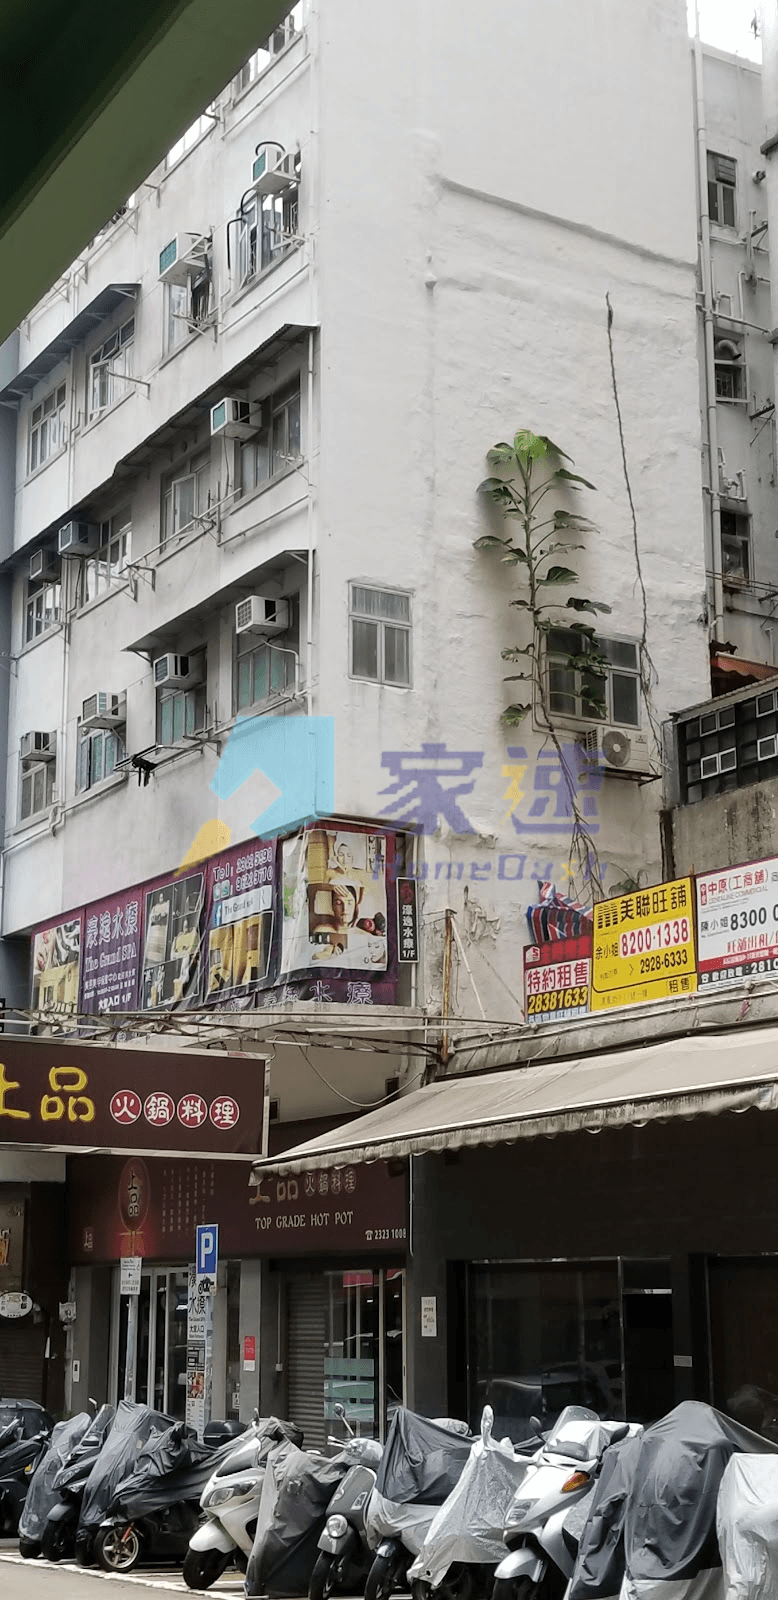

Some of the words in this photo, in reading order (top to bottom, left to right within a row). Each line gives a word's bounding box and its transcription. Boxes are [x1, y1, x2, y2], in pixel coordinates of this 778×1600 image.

[731, 907, 767, 931] 8300
[402, 949, 416, 959] 1/F
[527, 961, 589, 993] 特約租售
[527, 986, 589, 1014] 28381633
[112, 1092, 239, 1127] 火鍋料理
[255, 1217, 271, 1230] TOP
[276, 1214, 306, 1230] GRADE
[310, 1212, 329, 1227] HOT
[335, 1210, 354, 1225] POT
[375, 1229, 390, 1240] 2323
[201, 1231, 214, 1268] P
